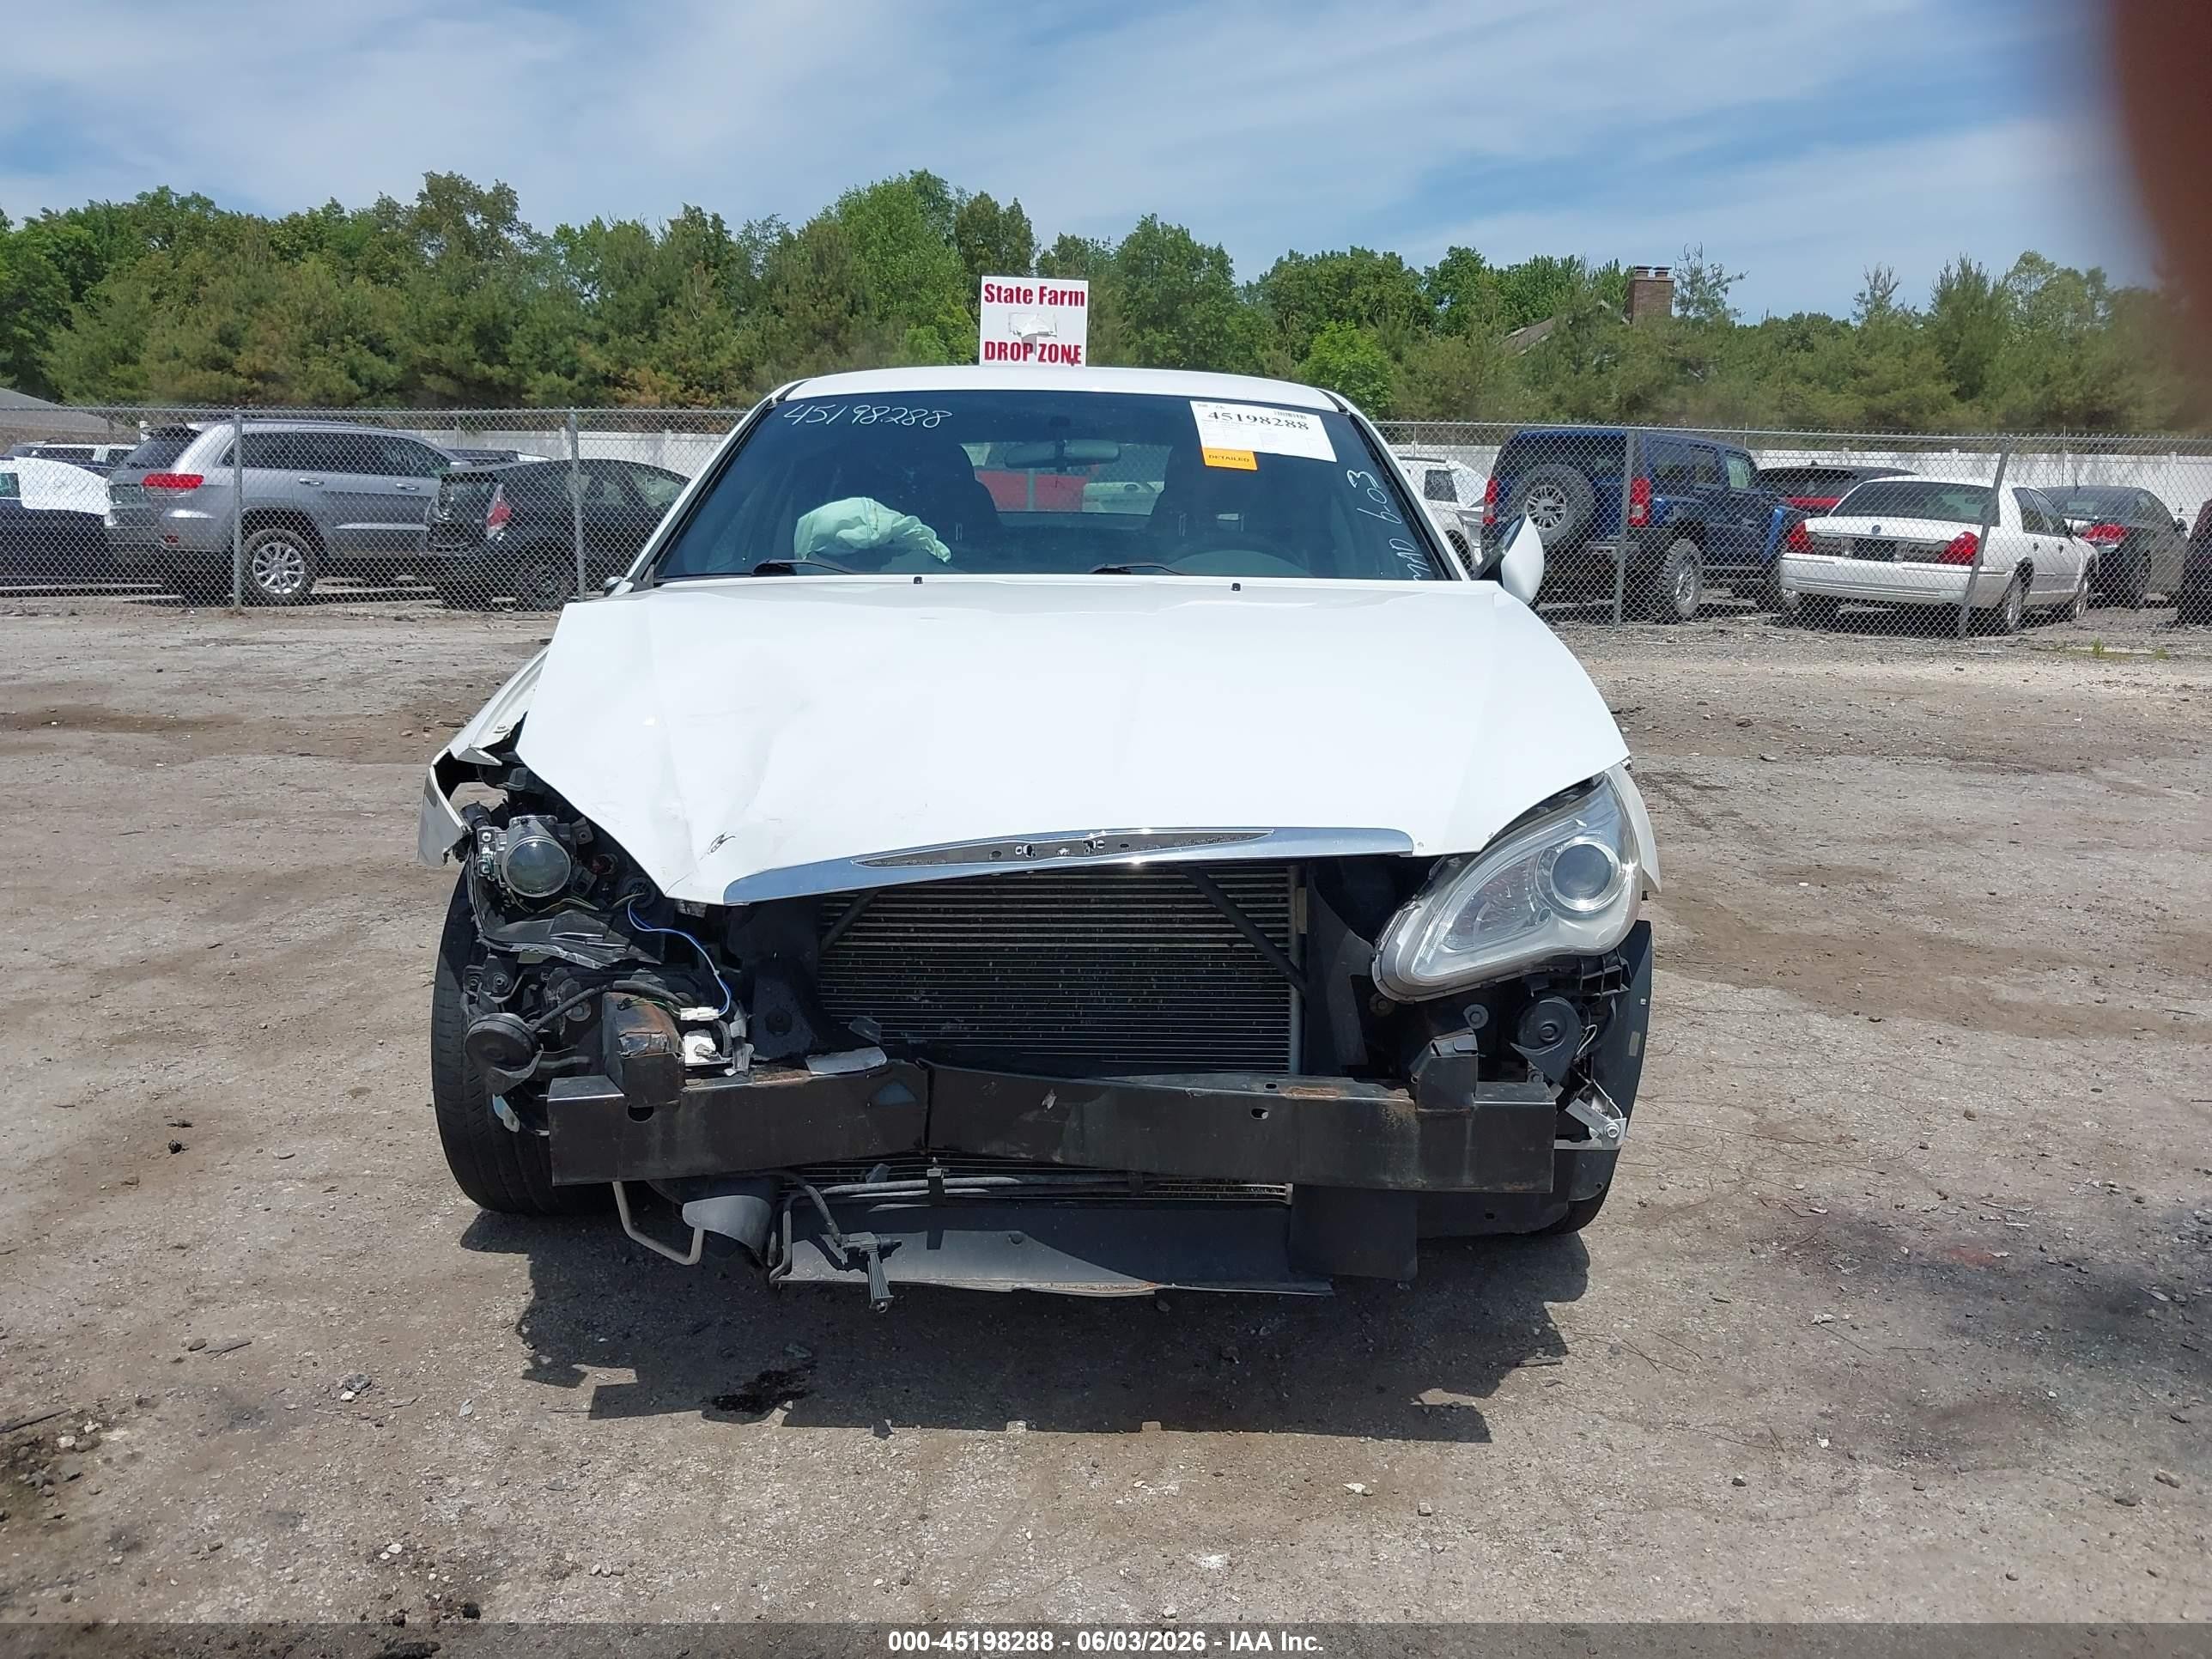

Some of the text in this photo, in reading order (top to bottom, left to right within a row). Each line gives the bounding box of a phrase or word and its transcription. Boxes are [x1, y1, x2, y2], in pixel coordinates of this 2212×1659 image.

[984, 283, 1085, 307] State Farm
[984, 341, 1082, 365] DROP ZONE
[783, 404, 953, 428] 45198288
[1208, 411, 1310, 431] 45198288
[1208, 453, 1250, 463] DETAILED
